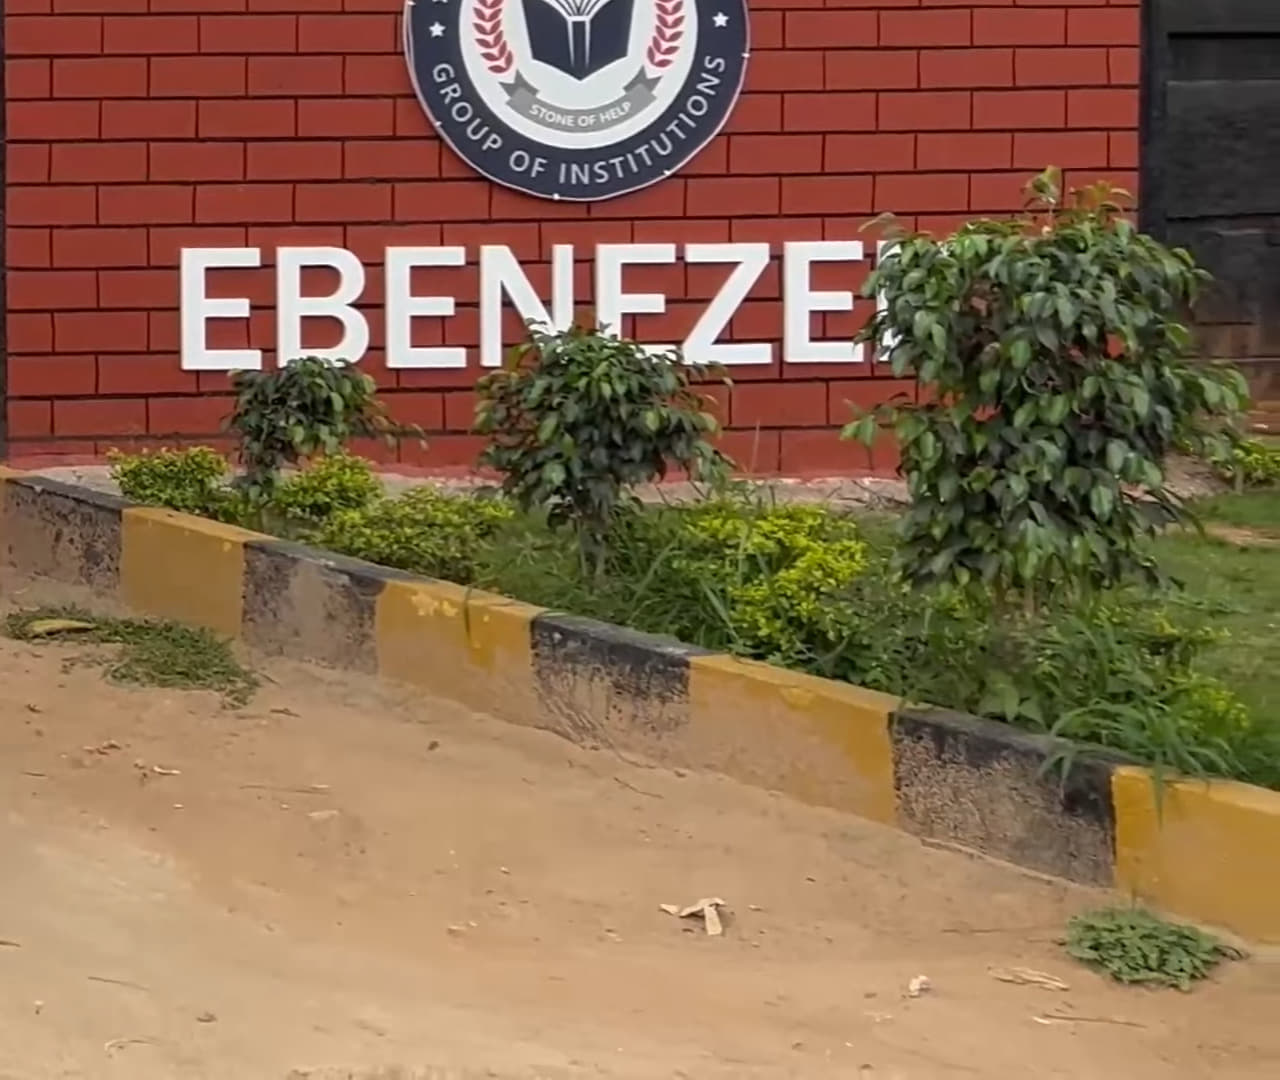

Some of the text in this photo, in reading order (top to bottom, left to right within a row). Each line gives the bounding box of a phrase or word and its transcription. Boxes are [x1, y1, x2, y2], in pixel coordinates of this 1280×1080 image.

[431, 55, 726, 185] GROUP OF INSTITUTIONS
[529, 101, 632, 128] STONE OF HELP
[180, 241, 906, 371] EBENEZE
